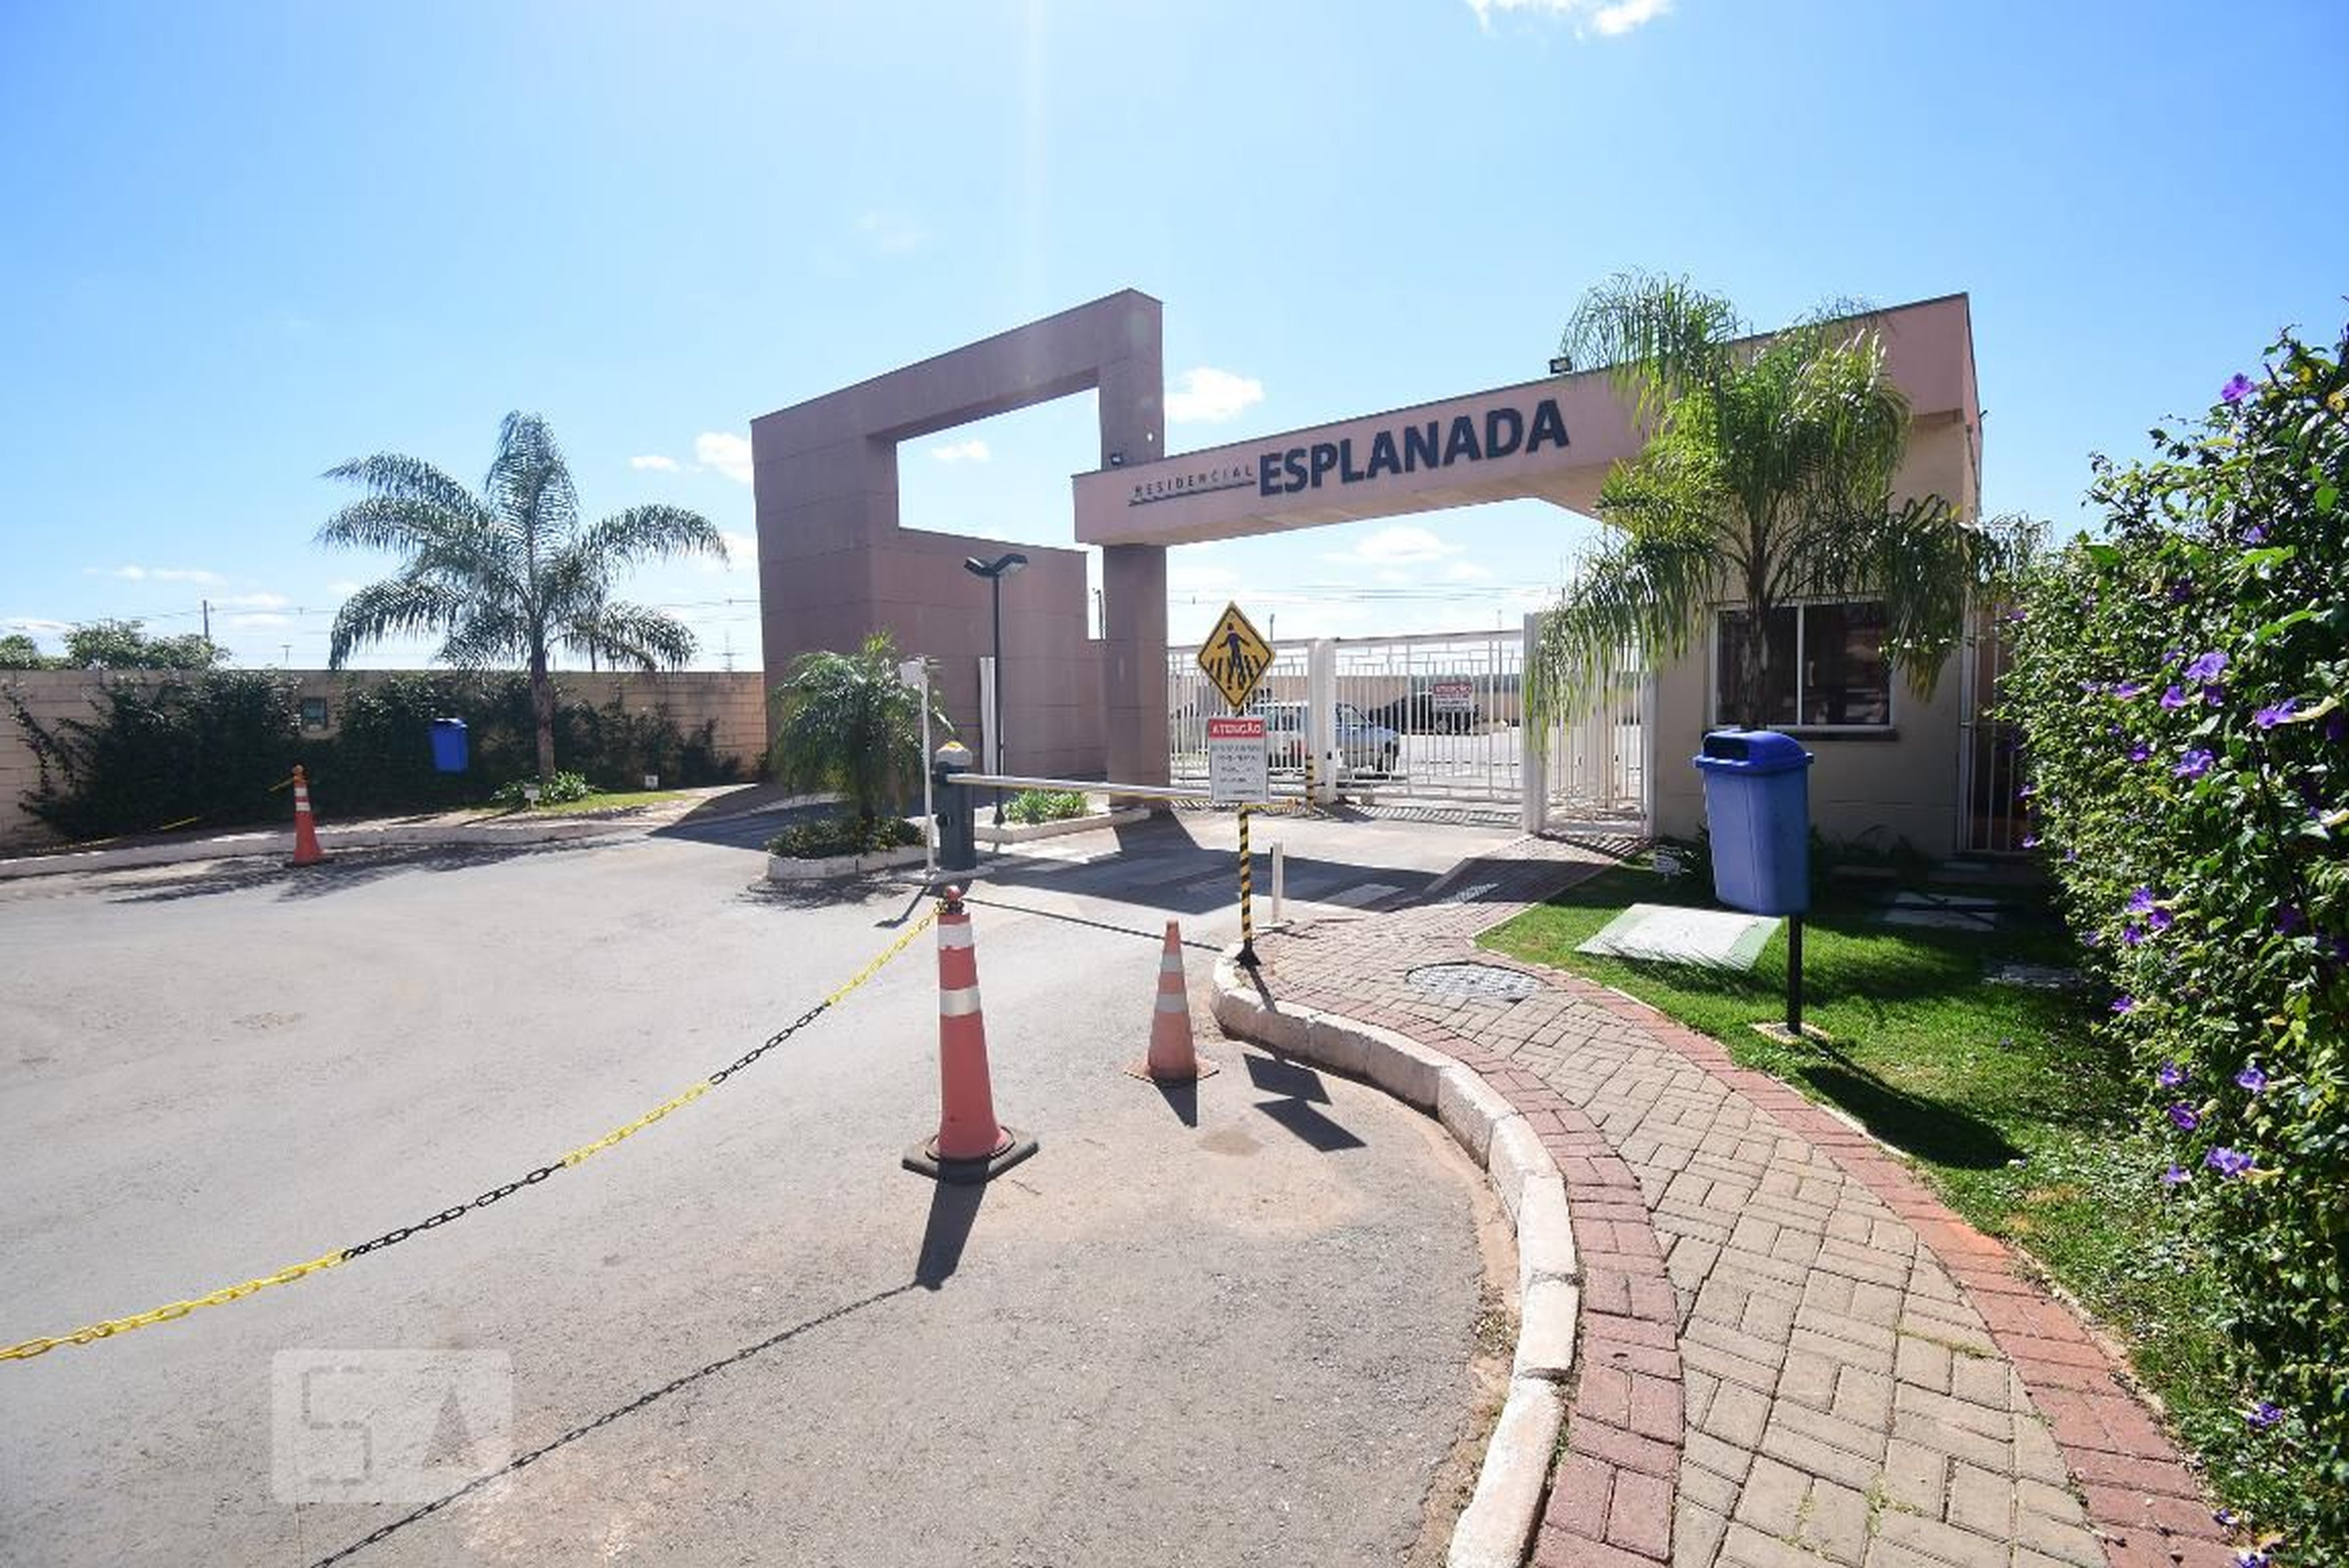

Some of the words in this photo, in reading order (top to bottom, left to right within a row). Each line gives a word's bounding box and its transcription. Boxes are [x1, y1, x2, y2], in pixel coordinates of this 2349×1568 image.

[1135, 465, 1252, 498] RESIDENCIAL
[1259, 399, 1570, 496] ESPLANADA
[1212, 722, 1261, 735] ATENÇÃO
